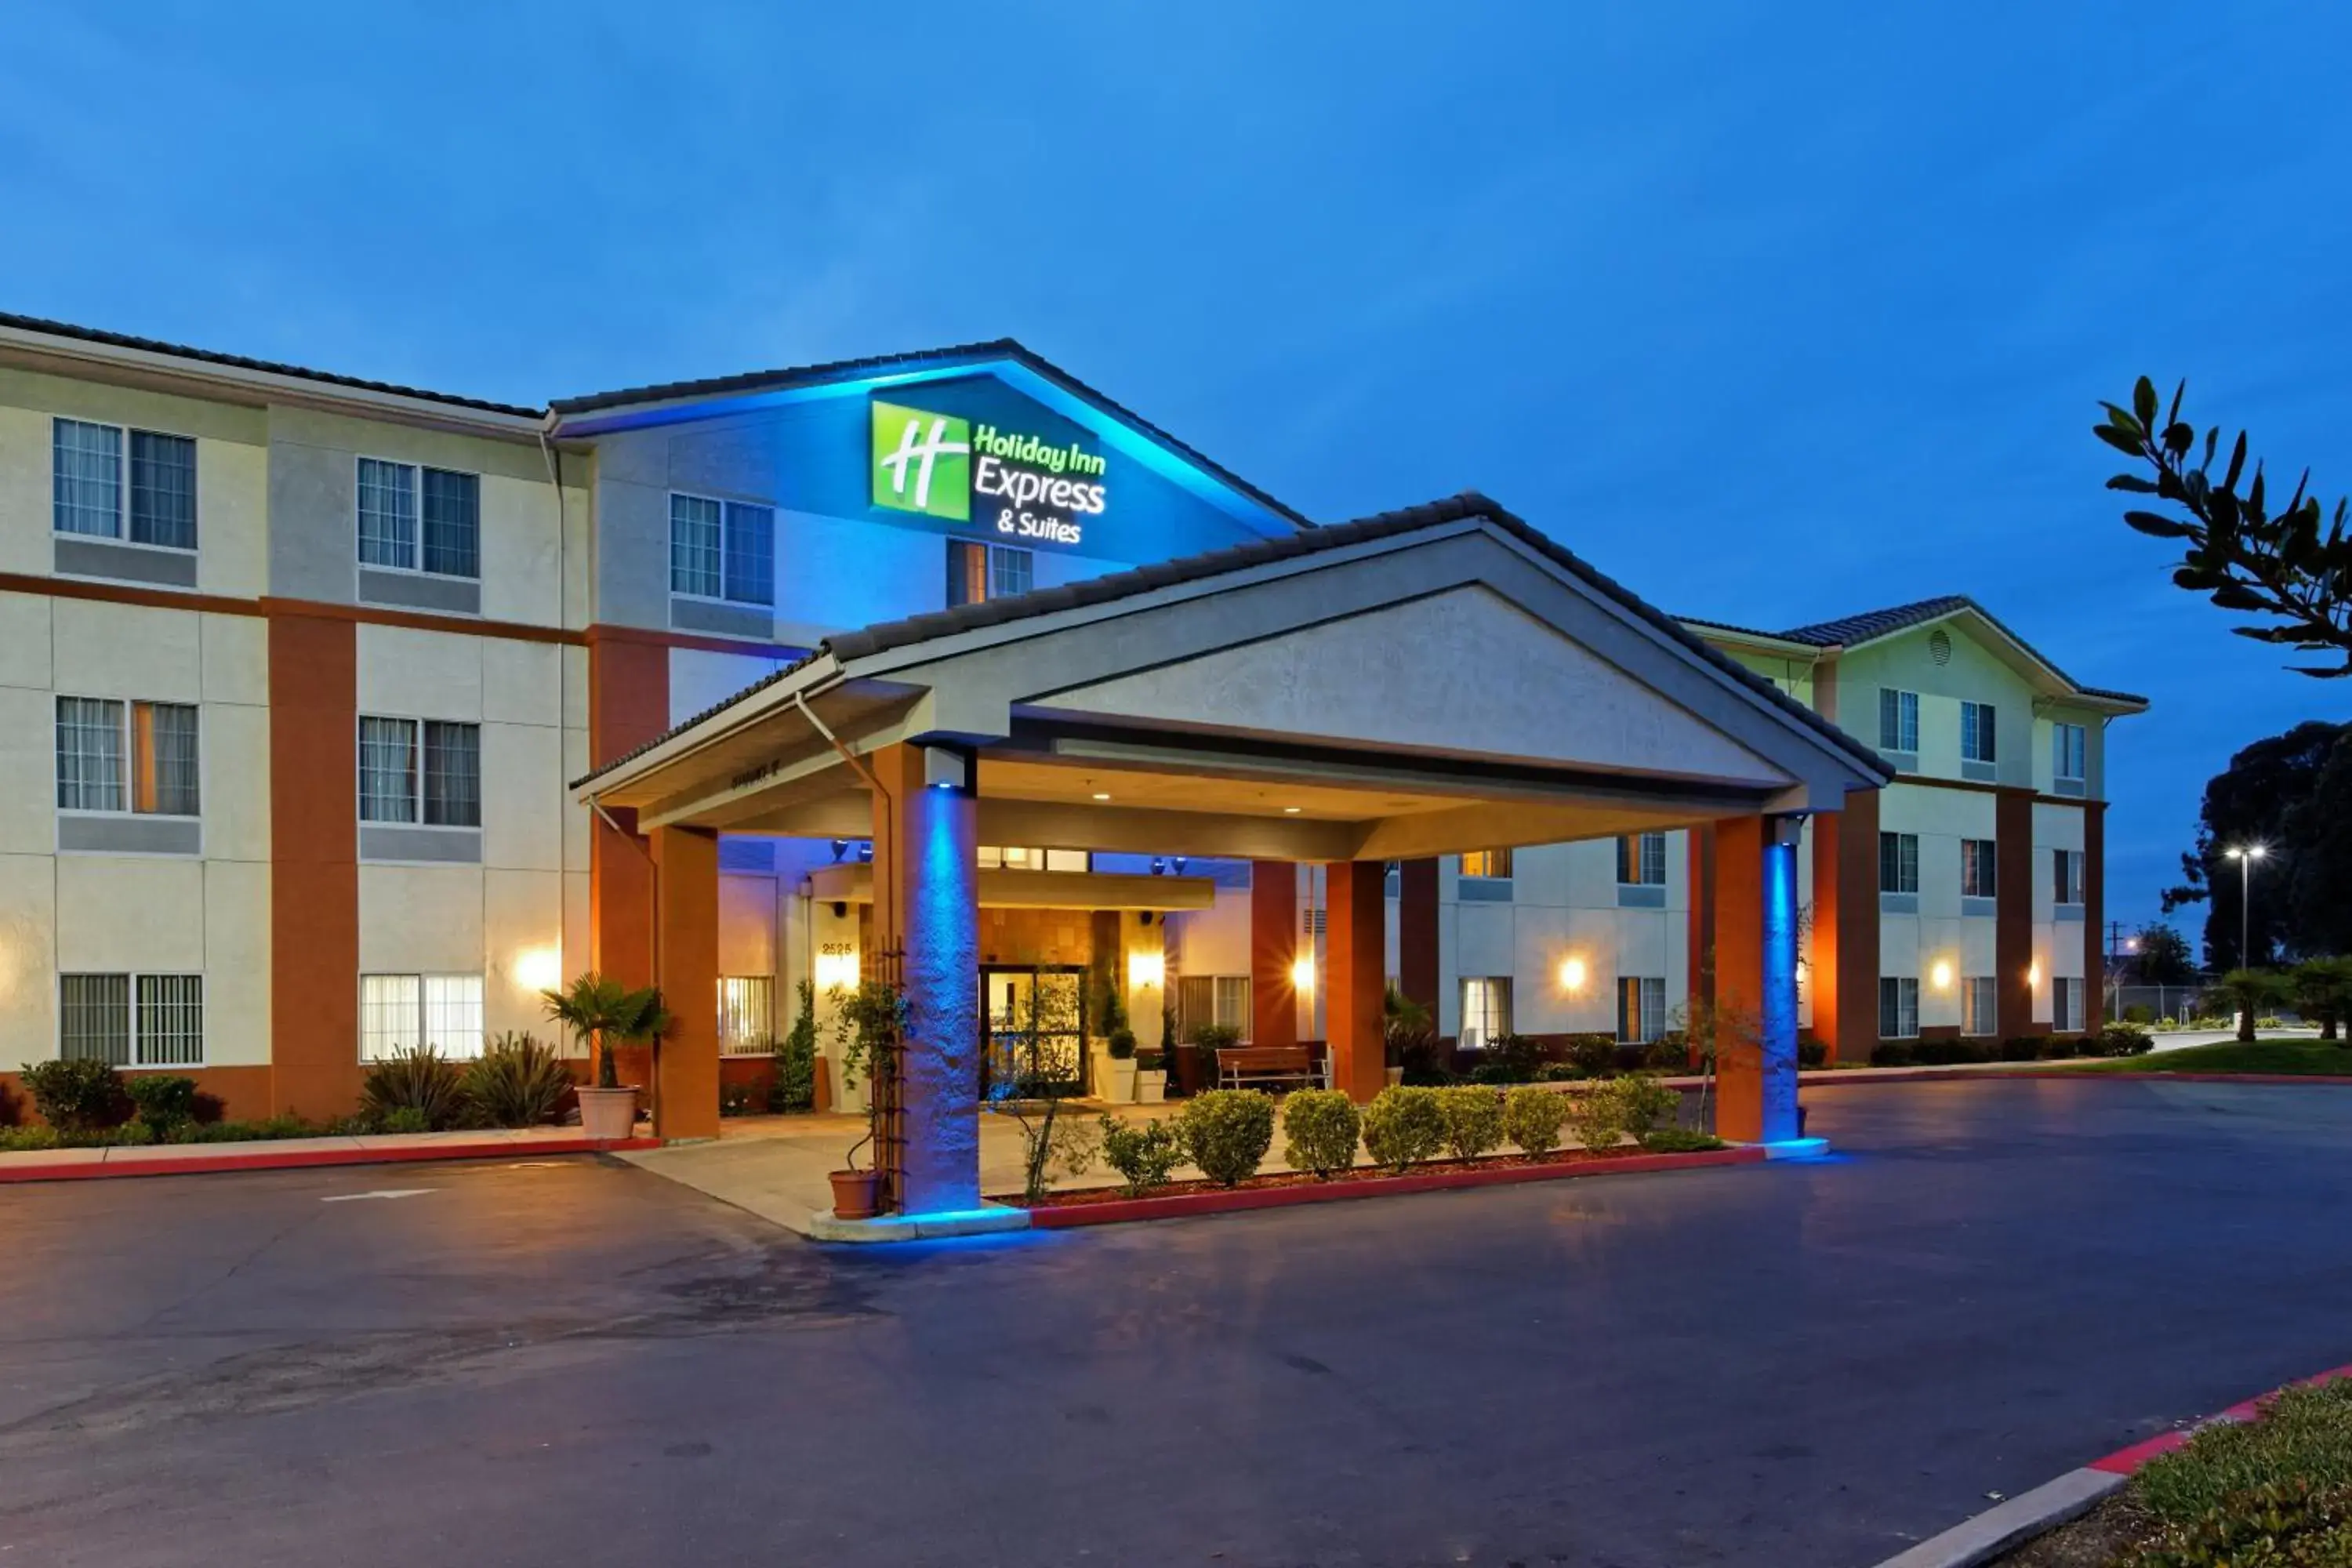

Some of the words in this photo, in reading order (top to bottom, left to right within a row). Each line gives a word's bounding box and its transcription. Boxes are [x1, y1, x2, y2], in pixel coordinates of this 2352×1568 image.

[974, 423, 1068, 474] Holiday
[1069, 444, 1106, 475] Inn
[974, 456, 1106, 514] Express
[997, 509, 1014, 534] &
[1018, 512, 1081, 544] Suites
[822, 943, 852, 955] 2525
